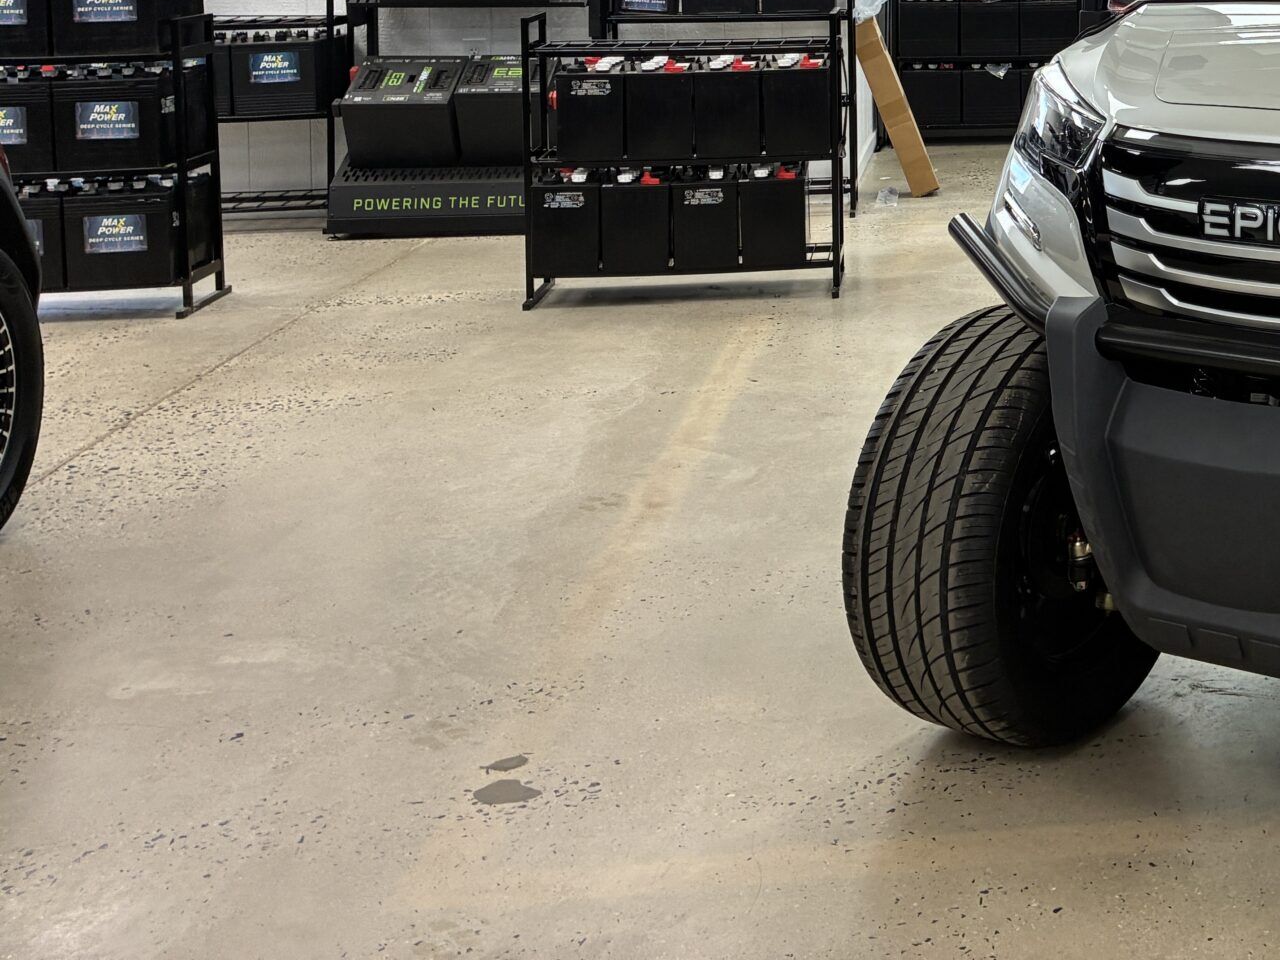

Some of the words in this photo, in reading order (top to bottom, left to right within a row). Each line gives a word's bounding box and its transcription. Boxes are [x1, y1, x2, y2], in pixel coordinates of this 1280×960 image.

[263, 54, 282, 63] MAX
[259, 61, 289, 69] POWER
[93, 104, 118, 113] MAX
[89, 113, 126, 122] POWER
[353, 197, 442, 211] POWERING
[448, 196, 480, 209] THE
[101, 218, 126, 227] MAX
[97, 226, 134, 235] POWER
